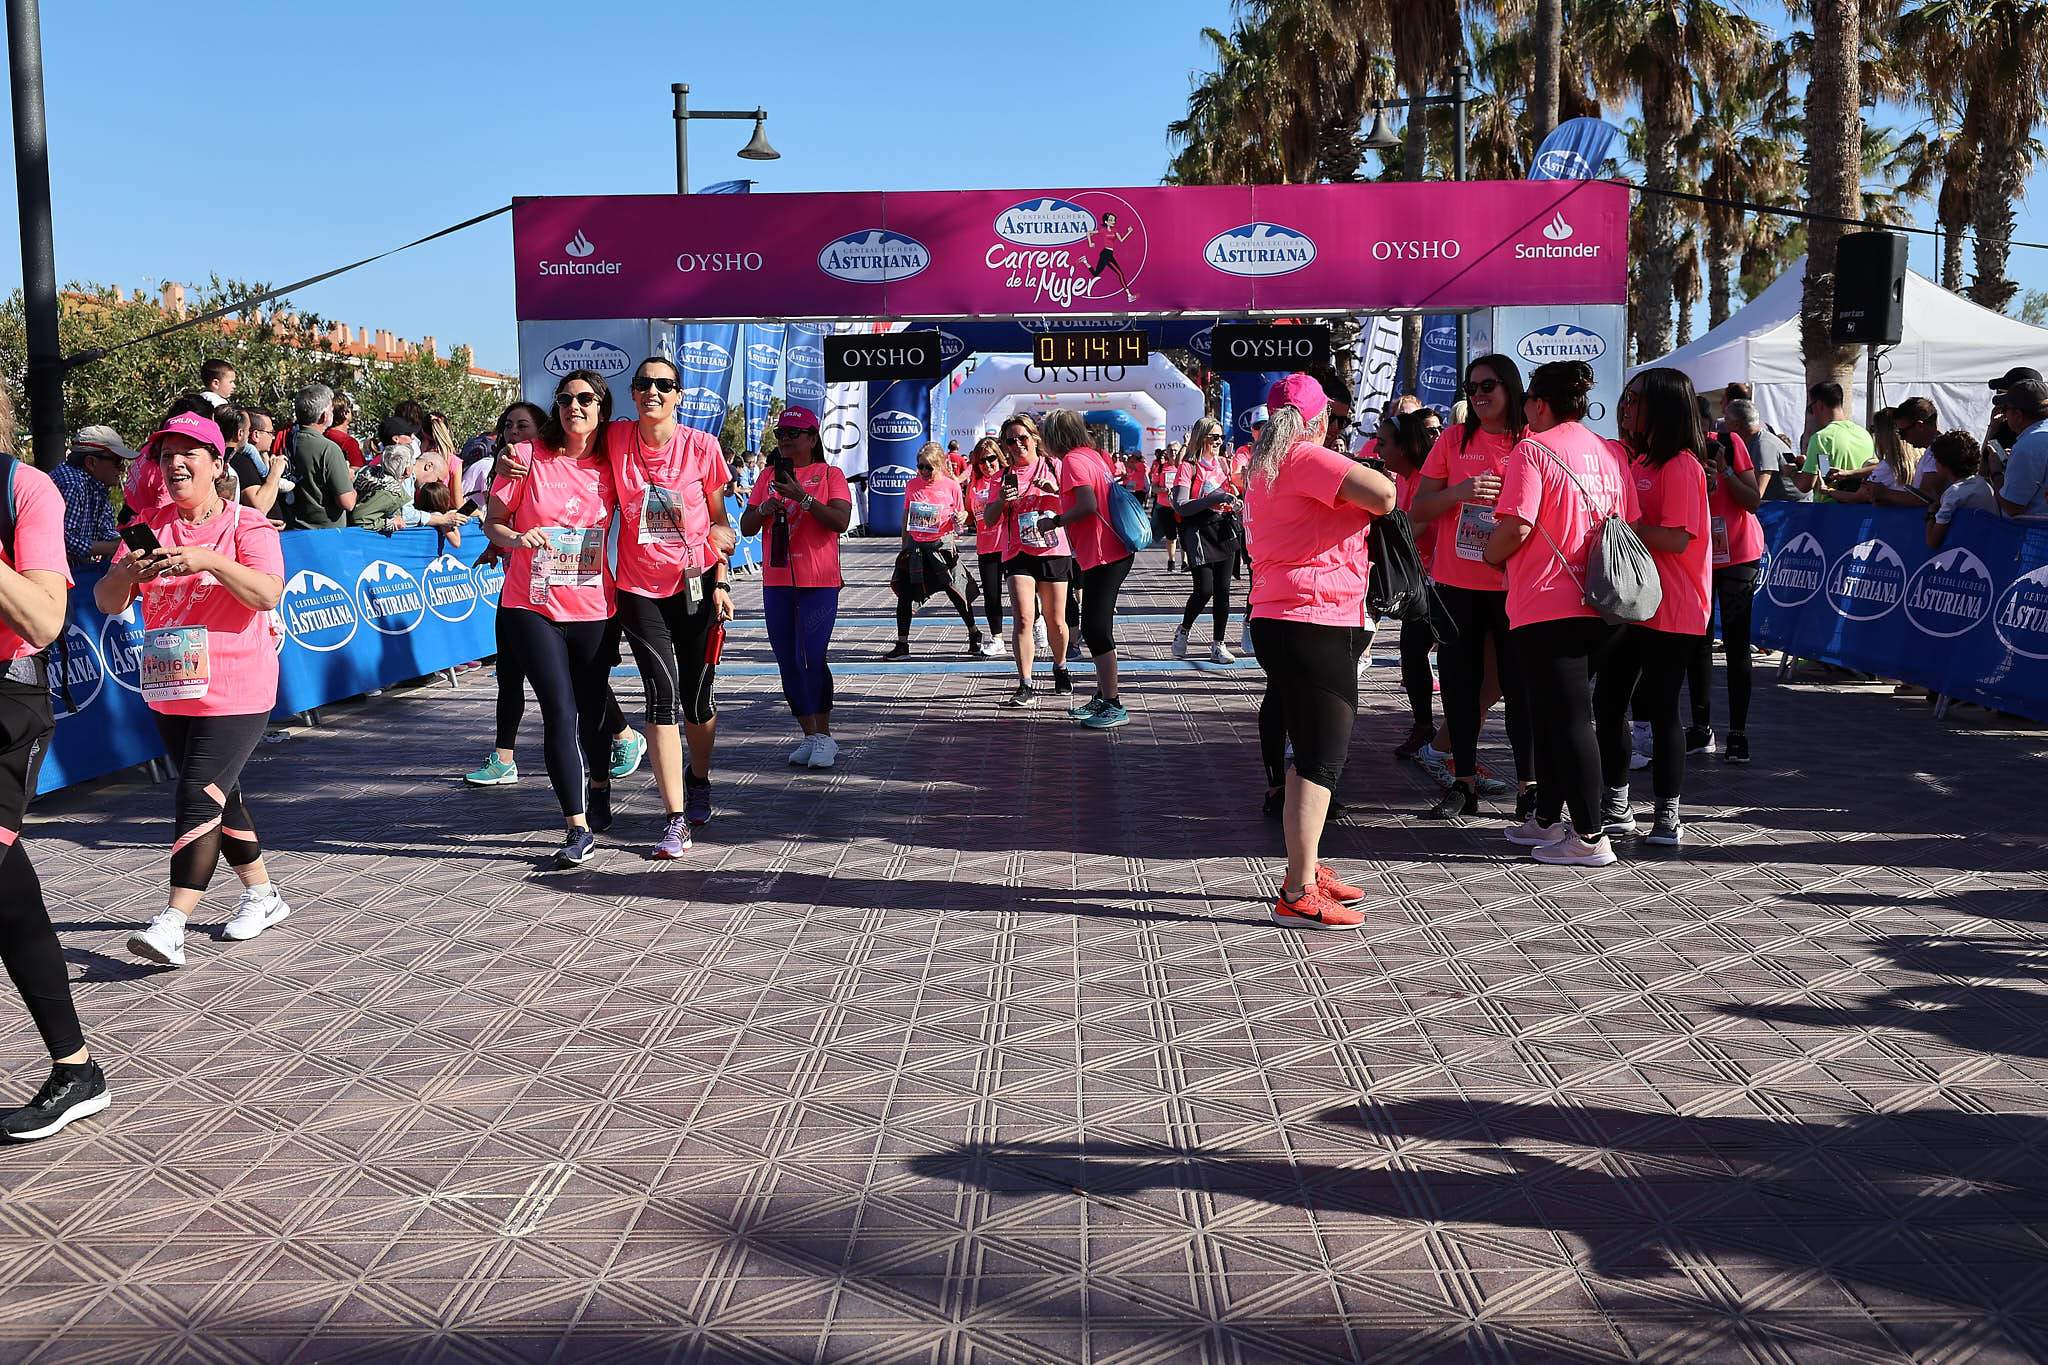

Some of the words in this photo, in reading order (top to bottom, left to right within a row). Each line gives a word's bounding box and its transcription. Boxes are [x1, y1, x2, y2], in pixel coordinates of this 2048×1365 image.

[1002, 216, 1088, 234] ASTURIANA
[827, 250, 921, 269] ASTURIANA
[985, 243, 1070, 269] Carrera
[1212, 243, 1307, 263] ASTURIANA
[1372, 239, 1460, 262] OYSHO
[1515, 241, 1600, 259] Santander
[539, 261, 622, 276] Santander
[676, 252, 763, 272] OYSHO
[1006, 269, 1022, 288] de
[1025, 269, 1037, 288] la
[1034, 265, 1102, 308] Mujer
[843, 347, 925, 367] OYSHO
[1230, 339, 1313, 358] OYSHO
[1523, 340, 1599, 356] ASTURIANA
[550, 354, 624, 371] ASTURIANA
[681, 350, 727, 367] ASTURIANA
[1024, 364, 1125, 383] OYSHO
[1355, 315, 1401, 437] OYSH
[872, 421, 918, 434] ASTURIANA
[1583, 454, 1599, 472] TU
[559, 553, 582, 563] 016
[1770, 560, 1819, 590] ASTURIANA
[1830, 565, 1897, 604] ASTURIANA
[1929, 575, 1955, 587] CENTRAL
[295, 598, 320, 608] CENTRAL
[320, 593, 345, 603] LECHERA
[428, 580, 475, 607] ASTURIANA
[1908, 576, 1982, 619] ASTURIANA
[363, 590, 422, 620] ASTURIANA
[288, 603, 354, 635] ASTURIANA
[158, 660, 182, 673] 016
